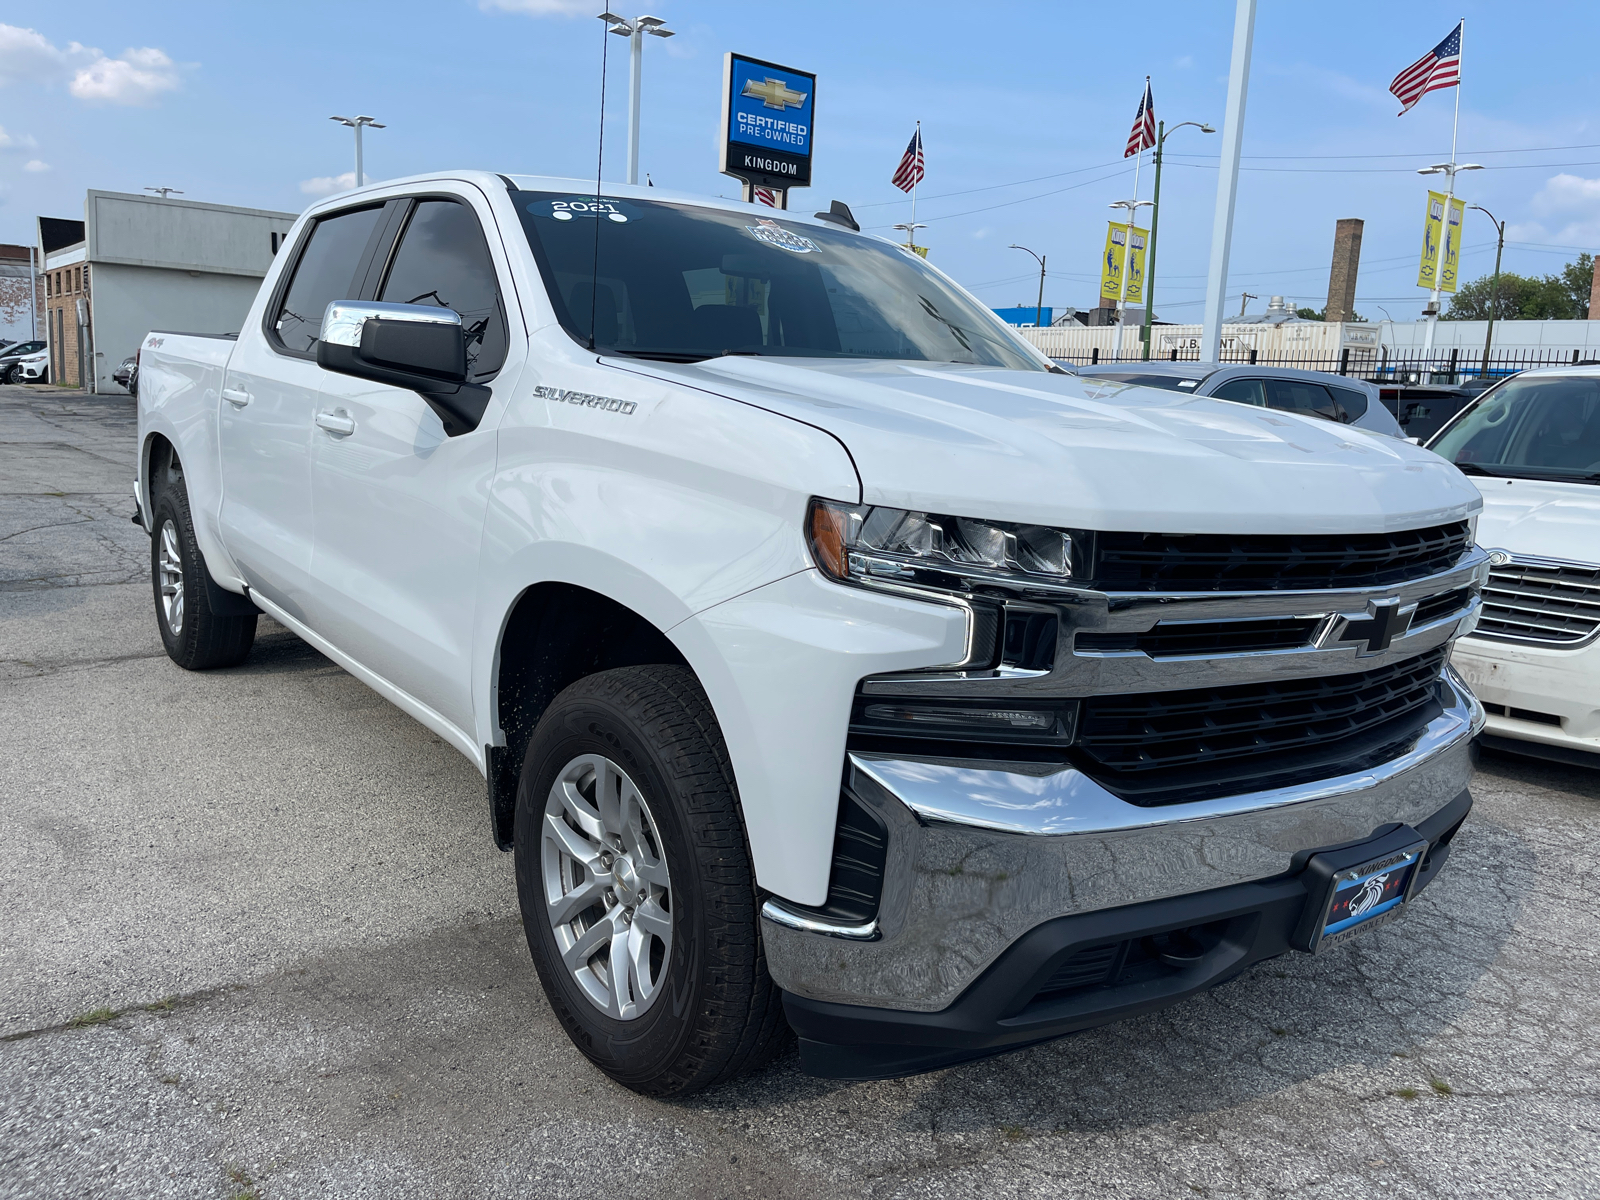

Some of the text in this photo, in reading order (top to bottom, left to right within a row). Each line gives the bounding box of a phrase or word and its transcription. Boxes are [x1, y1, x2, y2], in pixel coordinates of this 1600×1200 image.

[737, 112, 807, 136] CERTIFIED
[739, 124, 804, 146] PRE-OWNED
[744, 155, 797, 175] KINGDOM
[551, 201, 620, 213] 2021
[1111, 227, 1126, 246] King
[1179, 339, 1235, 349] J.B. NT
[533, 385, 638, 415] SILVERADO
[1337, 916, 1386, 943] CHEVROLET
